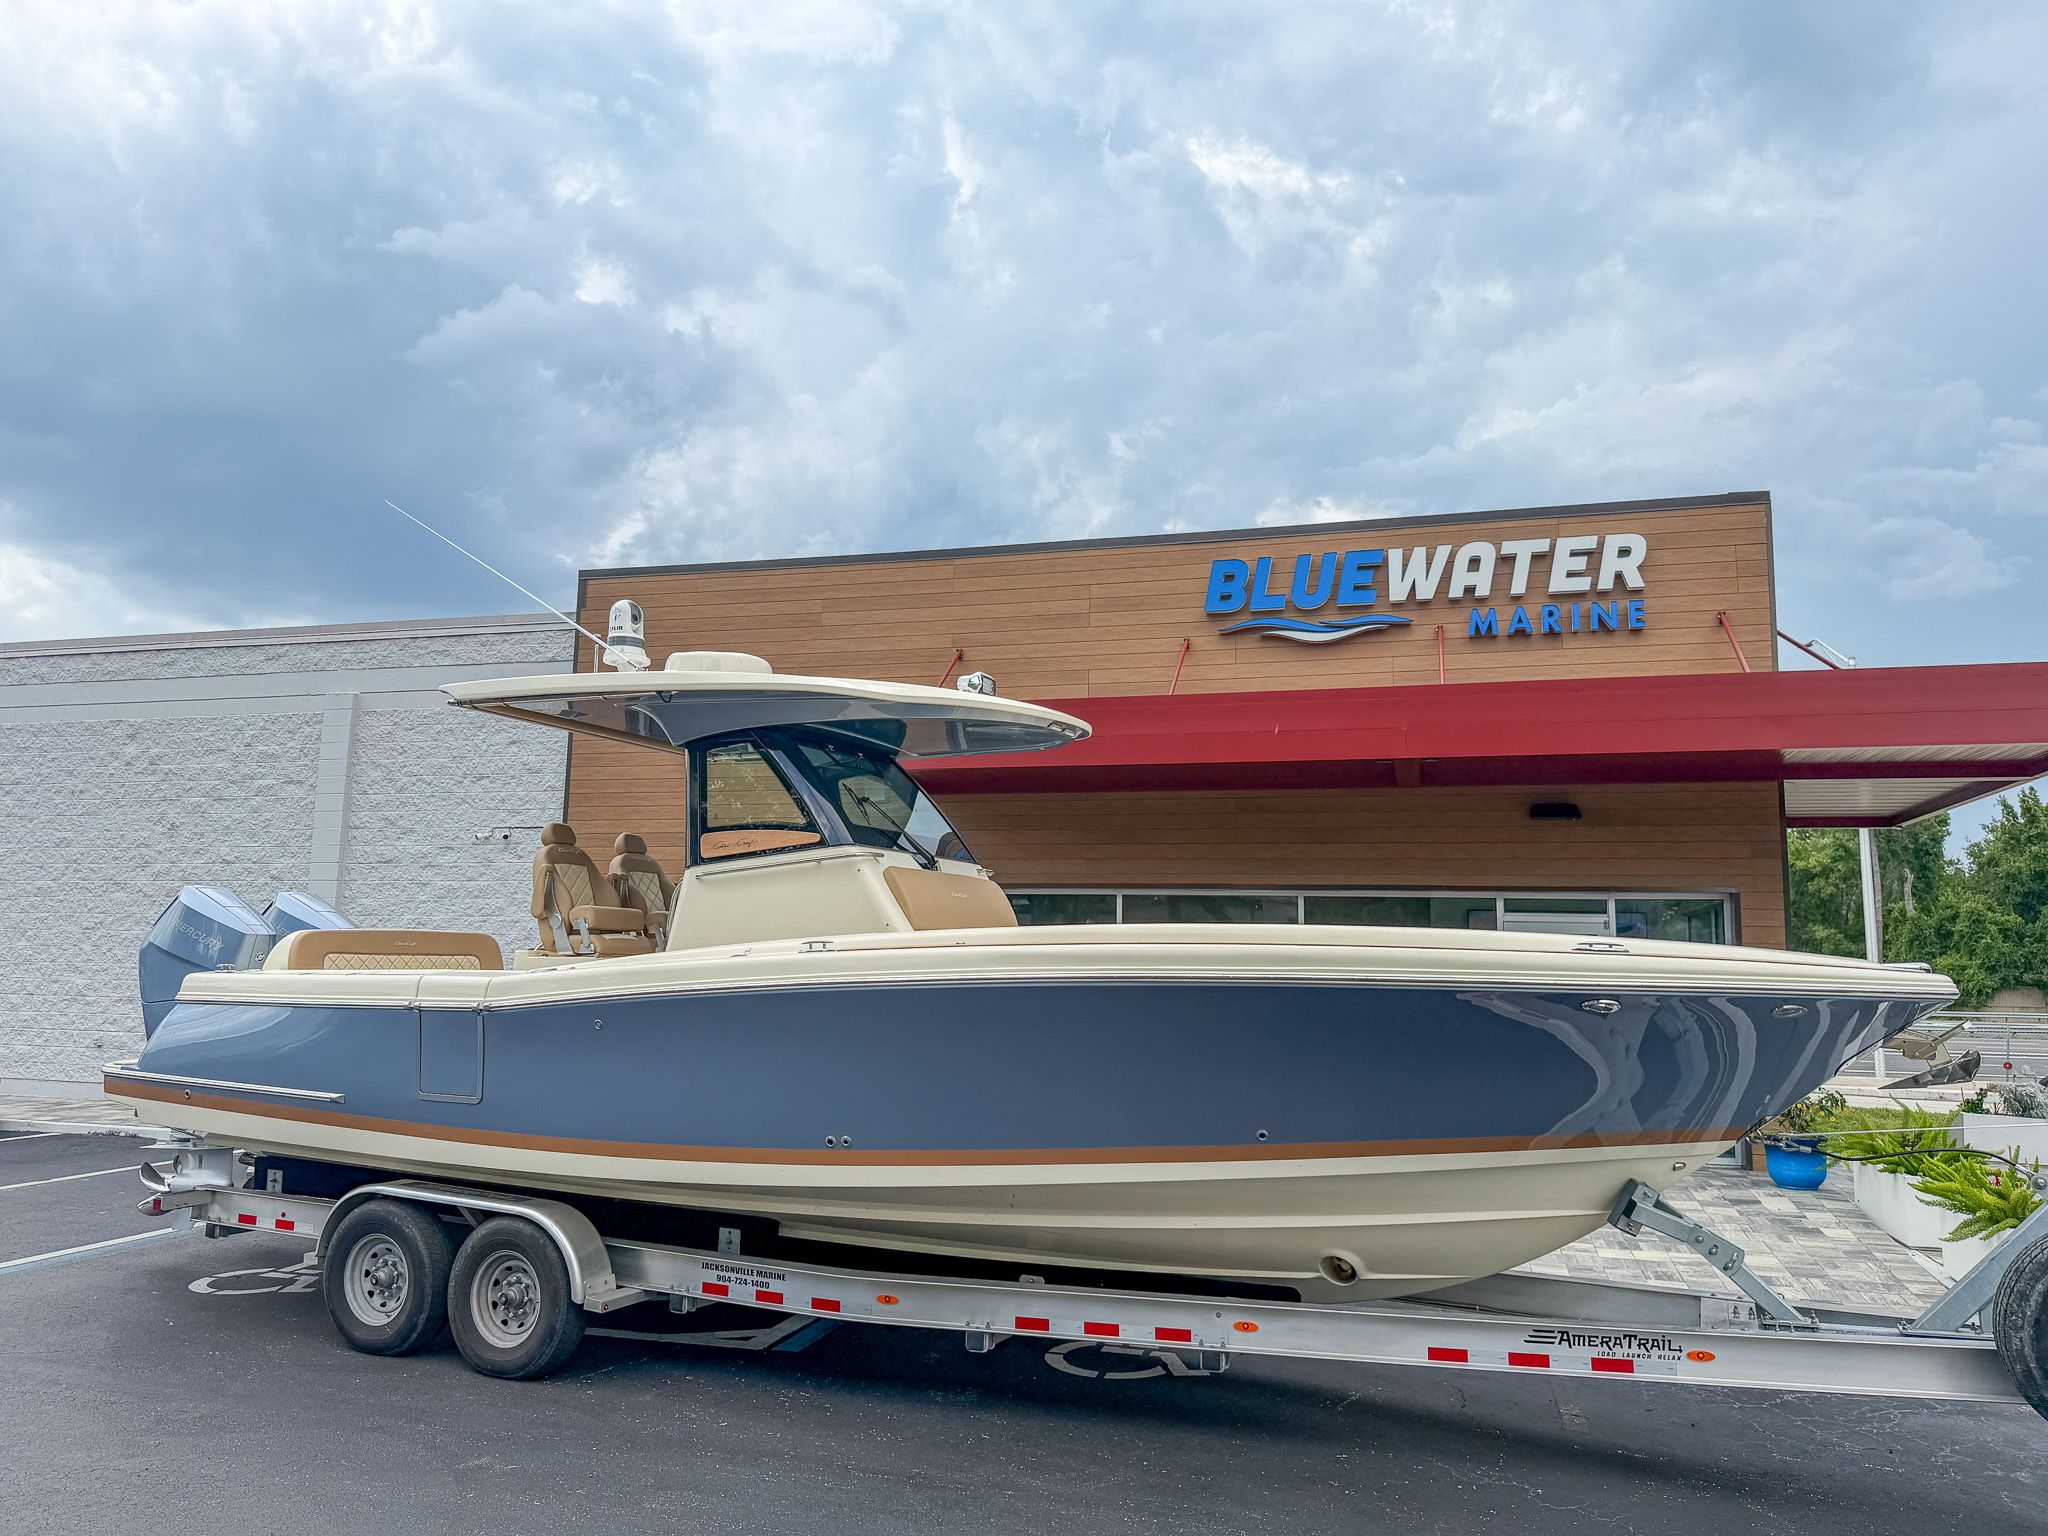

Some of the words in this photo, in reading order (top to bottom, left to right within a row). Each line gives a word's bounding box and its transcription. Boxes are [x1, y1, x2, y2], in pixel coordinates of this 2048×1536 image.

[1203, 533, 1648, 614] BLUEWATER
[1468, 600, 1647, 637] MARINE
[172, 919, 224, 951] MERCURY
[701, 1262, 755, 1276] JACKSONVILLE
[756, 1270, 786, 1281] MARINE
[716, 1274, 770, 1289] 904-724-1400
